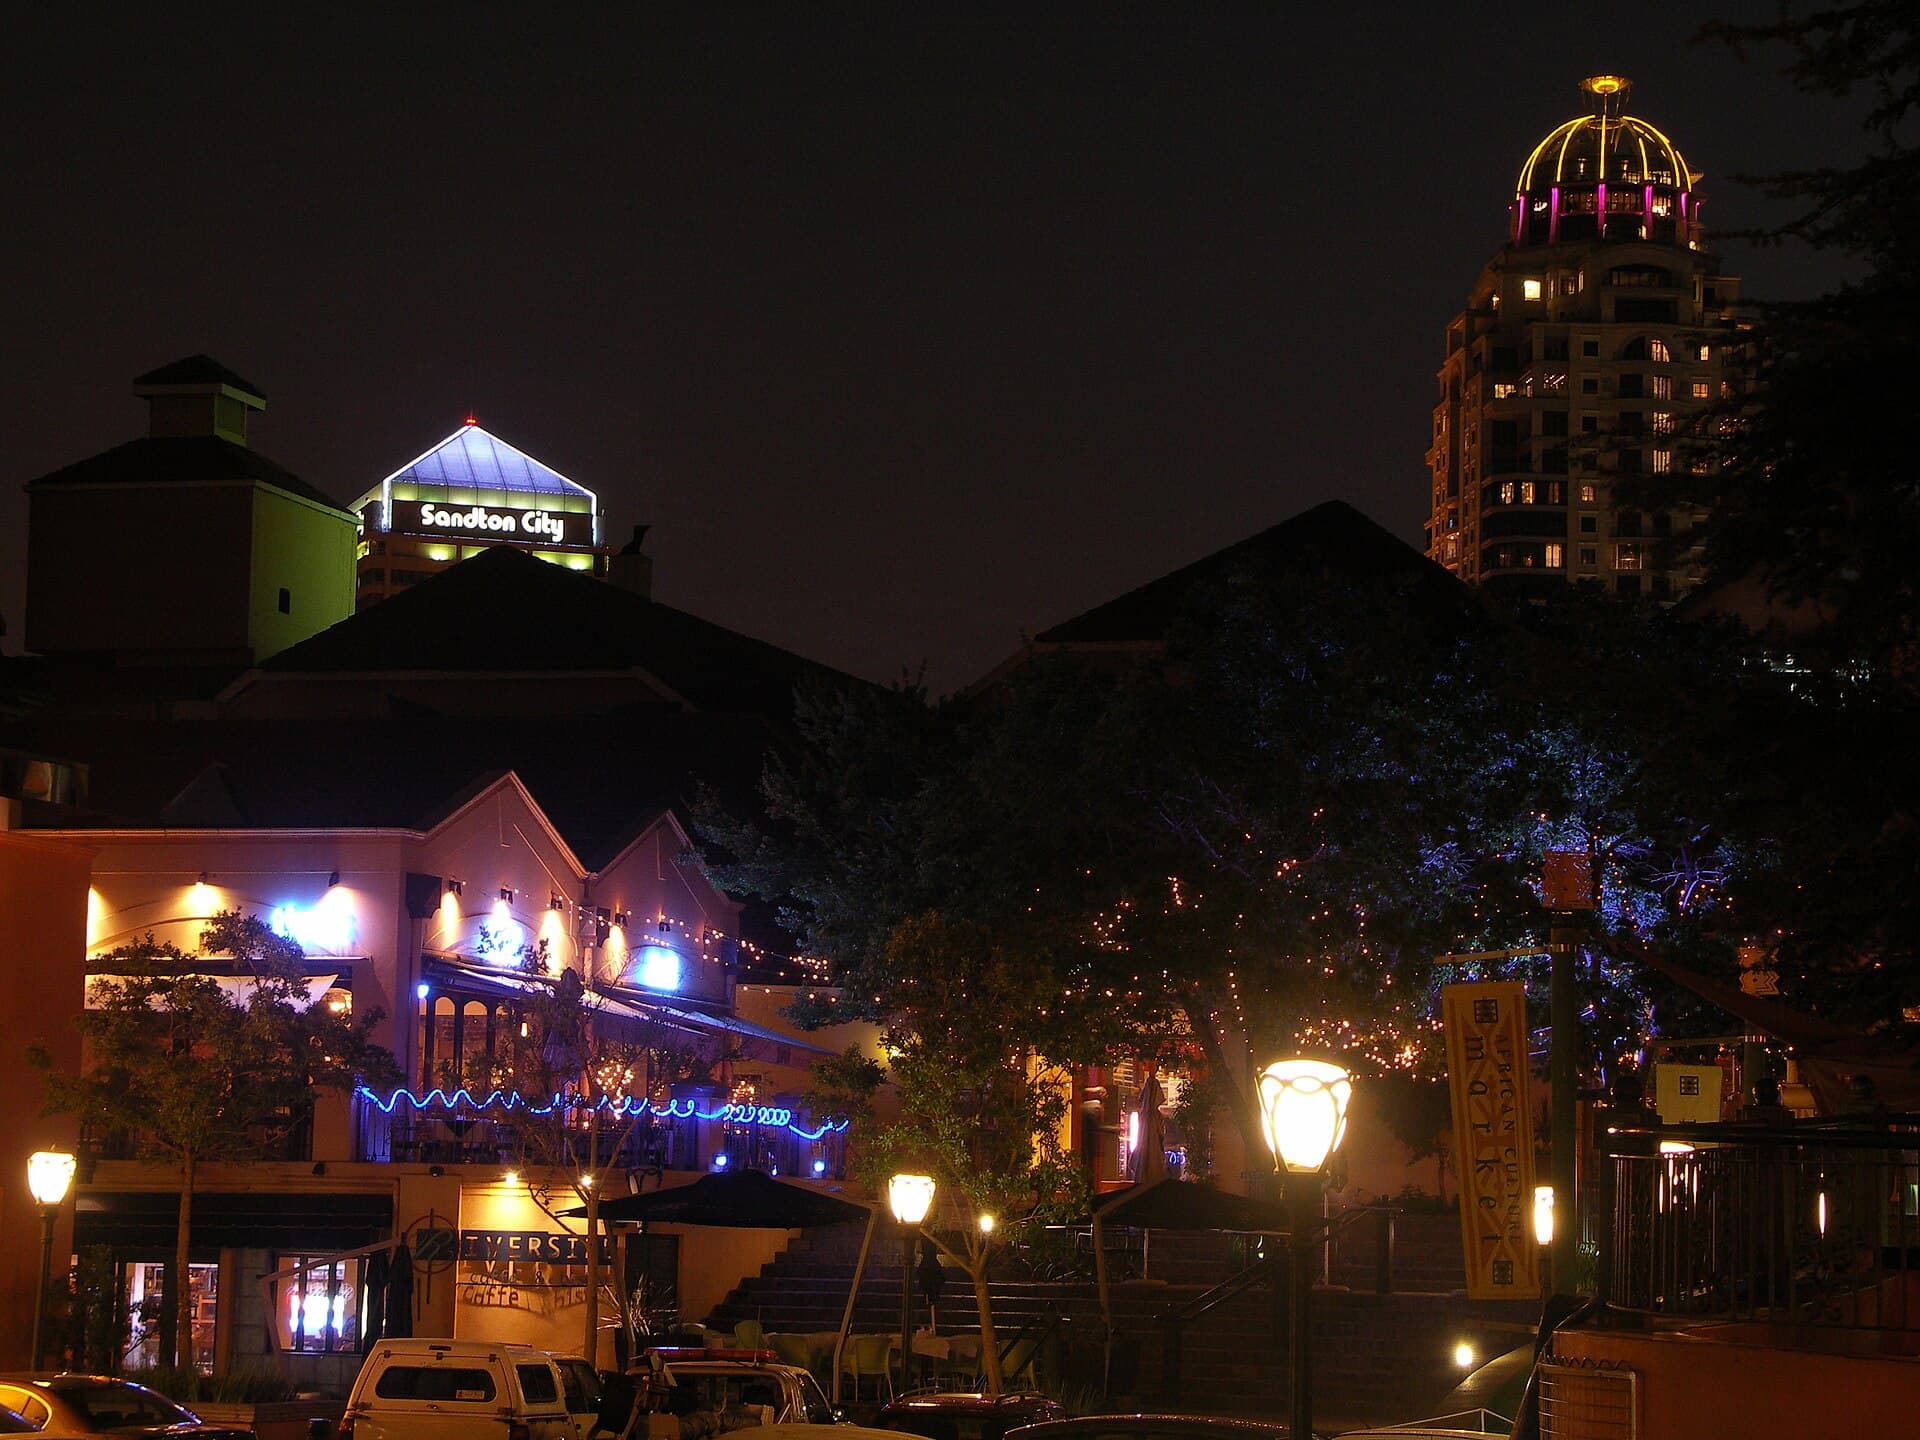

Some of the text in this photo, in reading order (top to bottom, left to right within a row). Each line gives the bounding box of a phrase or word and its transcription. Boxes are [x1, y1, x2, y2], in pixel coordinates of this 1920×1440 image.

[420, 503, 565, 543] Sandton City
[1464, 1035, 1503, 1243] market
[1496, 1034, 1522, 1244] AFRICAN CULTURE
